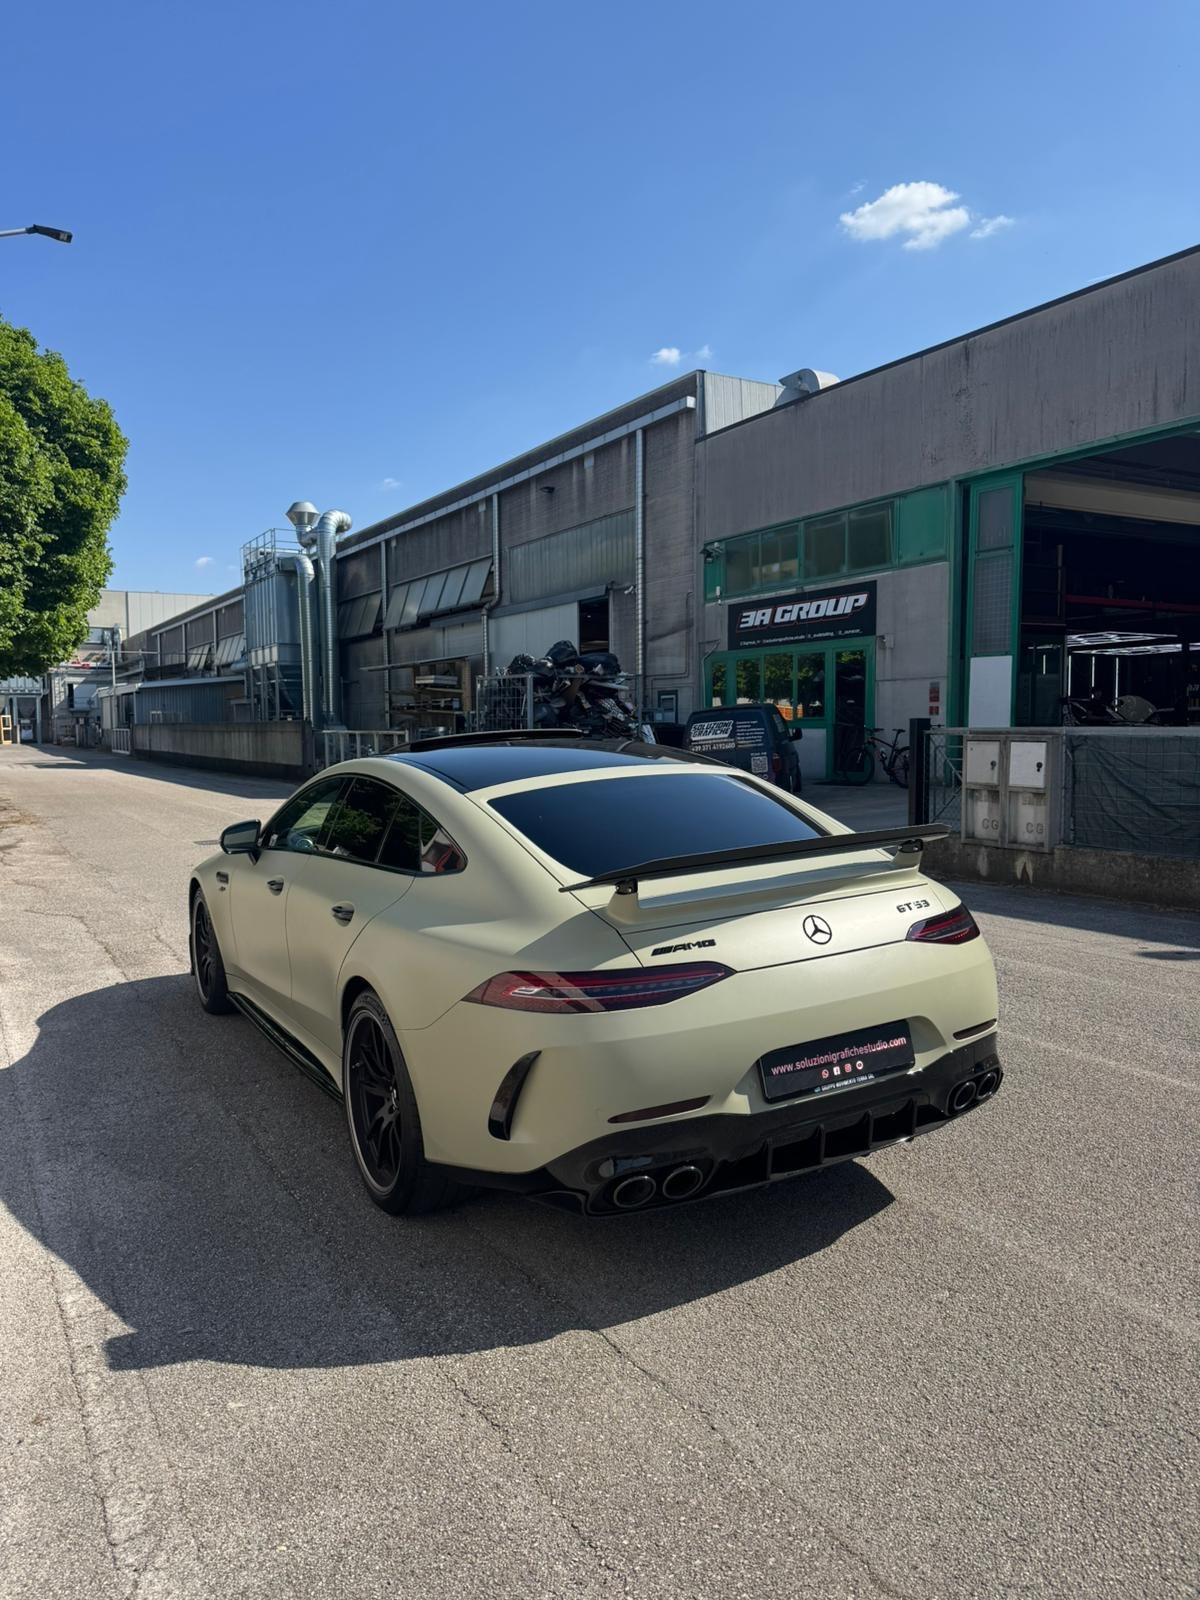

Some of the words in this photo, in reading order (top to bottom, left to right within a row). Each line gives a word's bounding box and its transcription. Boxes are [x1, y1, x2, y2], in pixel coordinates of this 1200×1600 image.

[740, 608, 772, 628] 3A
[774, 593, 868, 624] GROUP
[692, 721, 732, 731] SOLUZIONI
[692, 727, 730, 738] GRAFICHE
[896, 902, 912, 913] GT
[913, 899, 930, 909] 53
[672, 939, 717, 952] AMG
[771, 1036, 907, 1076] www.soluzionigrafichestudio.com
